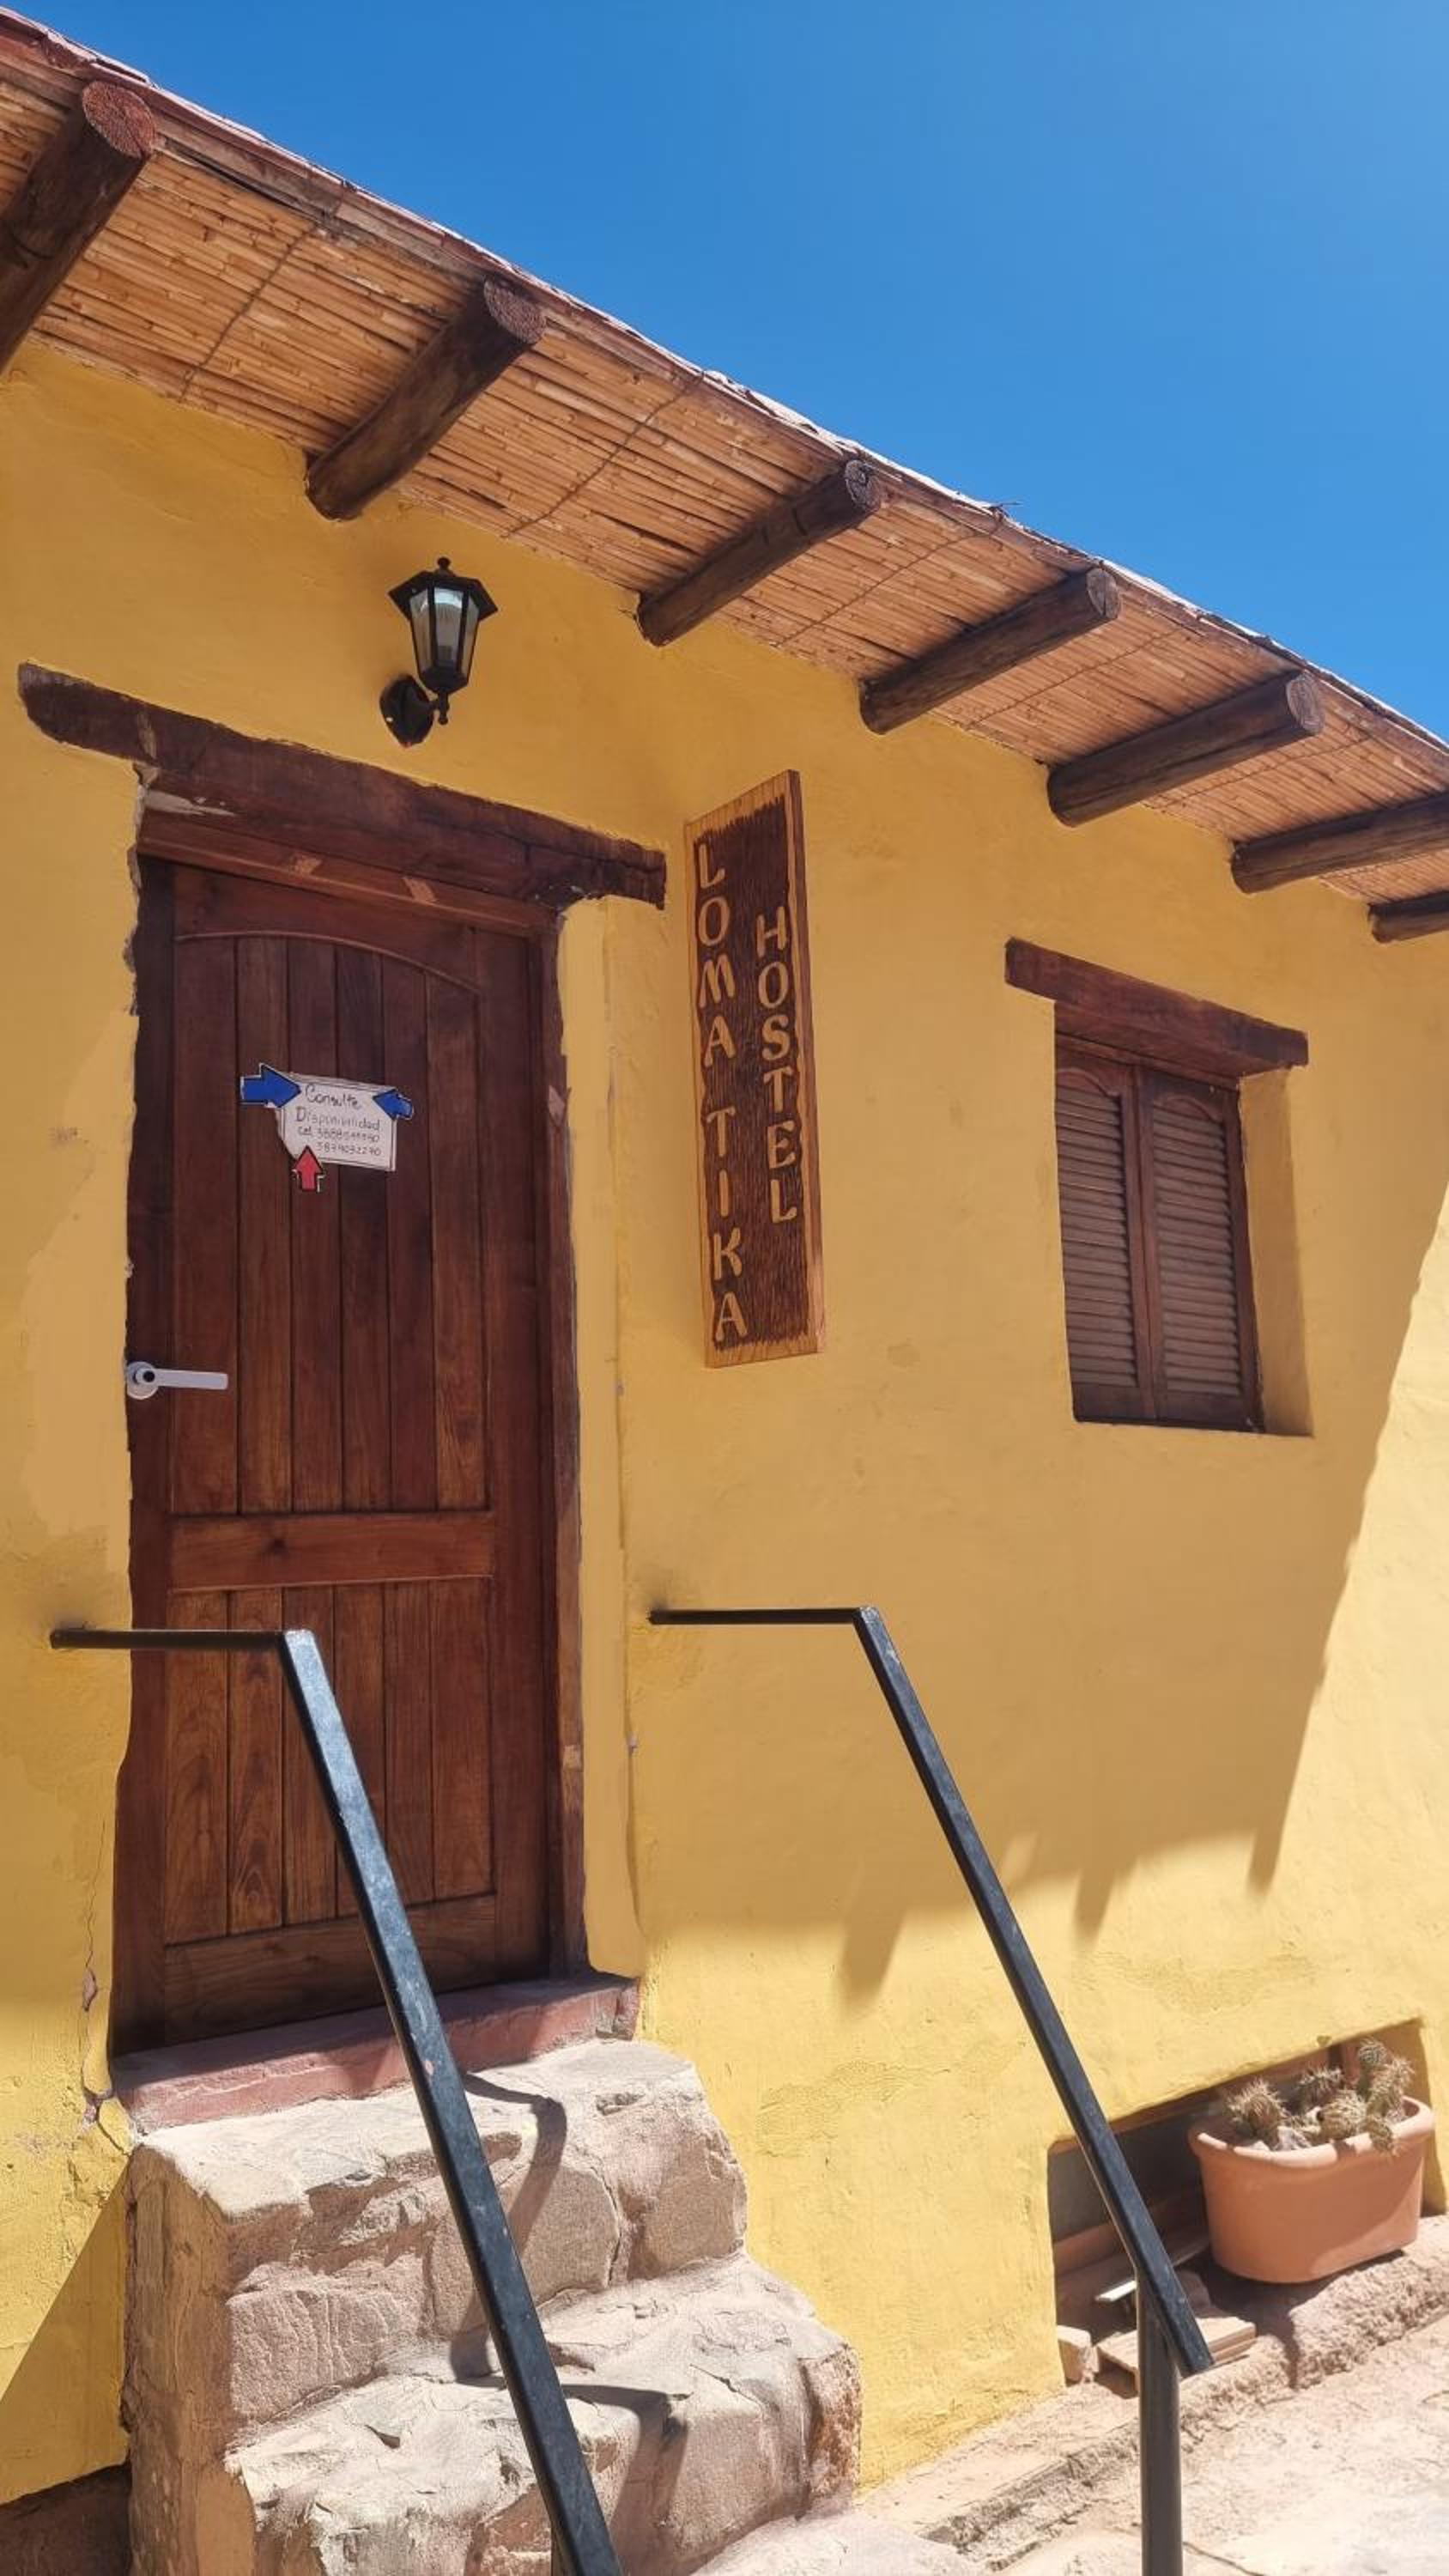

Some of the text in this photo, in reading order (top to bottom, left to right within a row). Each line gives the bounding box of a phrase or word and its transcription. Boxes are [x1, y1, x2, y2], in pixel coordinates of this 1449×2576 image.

[305, 1084, 362, 1111] Consulte
[697, 842, 748, 1343] LOMA TIKA
[755, 905, 798, 1224] HOSTEL
